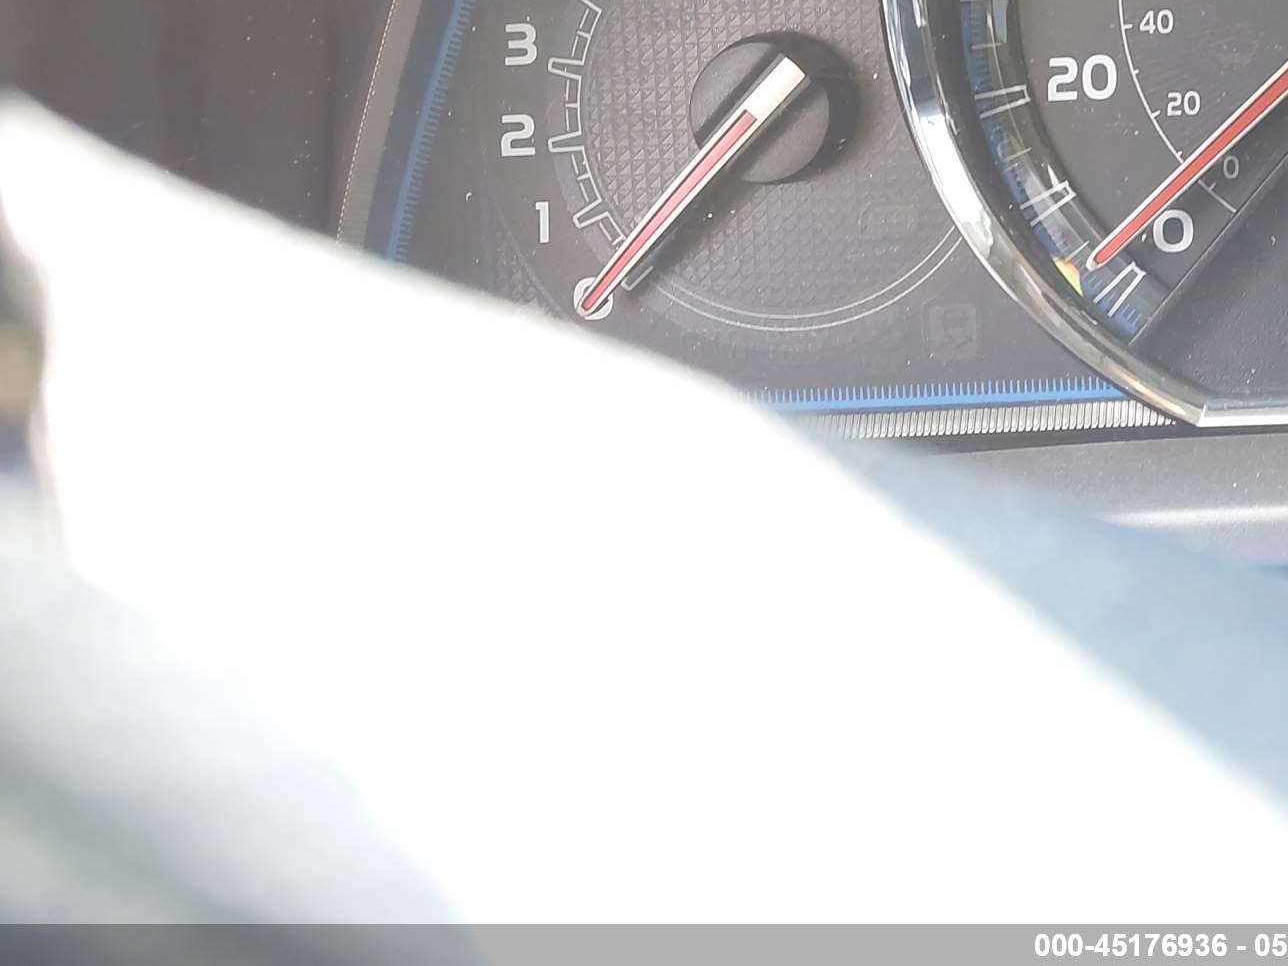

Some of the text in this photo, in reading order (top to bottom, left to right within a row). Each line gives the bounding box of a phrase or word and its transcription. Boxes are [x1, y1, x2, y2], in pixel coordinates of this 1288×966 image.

[1140, 9, 1175, 35] 40
[504, 23, 538, 66] 3
[1046, 54, 1119, 102] 20
[1165, 91, 1201, 117] 20
[501, 114, 536, 157] 2
[1222, 155, 1240, 180] 0
[535, 202, 550, 243] 1
[1152, 208, 1195, 254] 0
